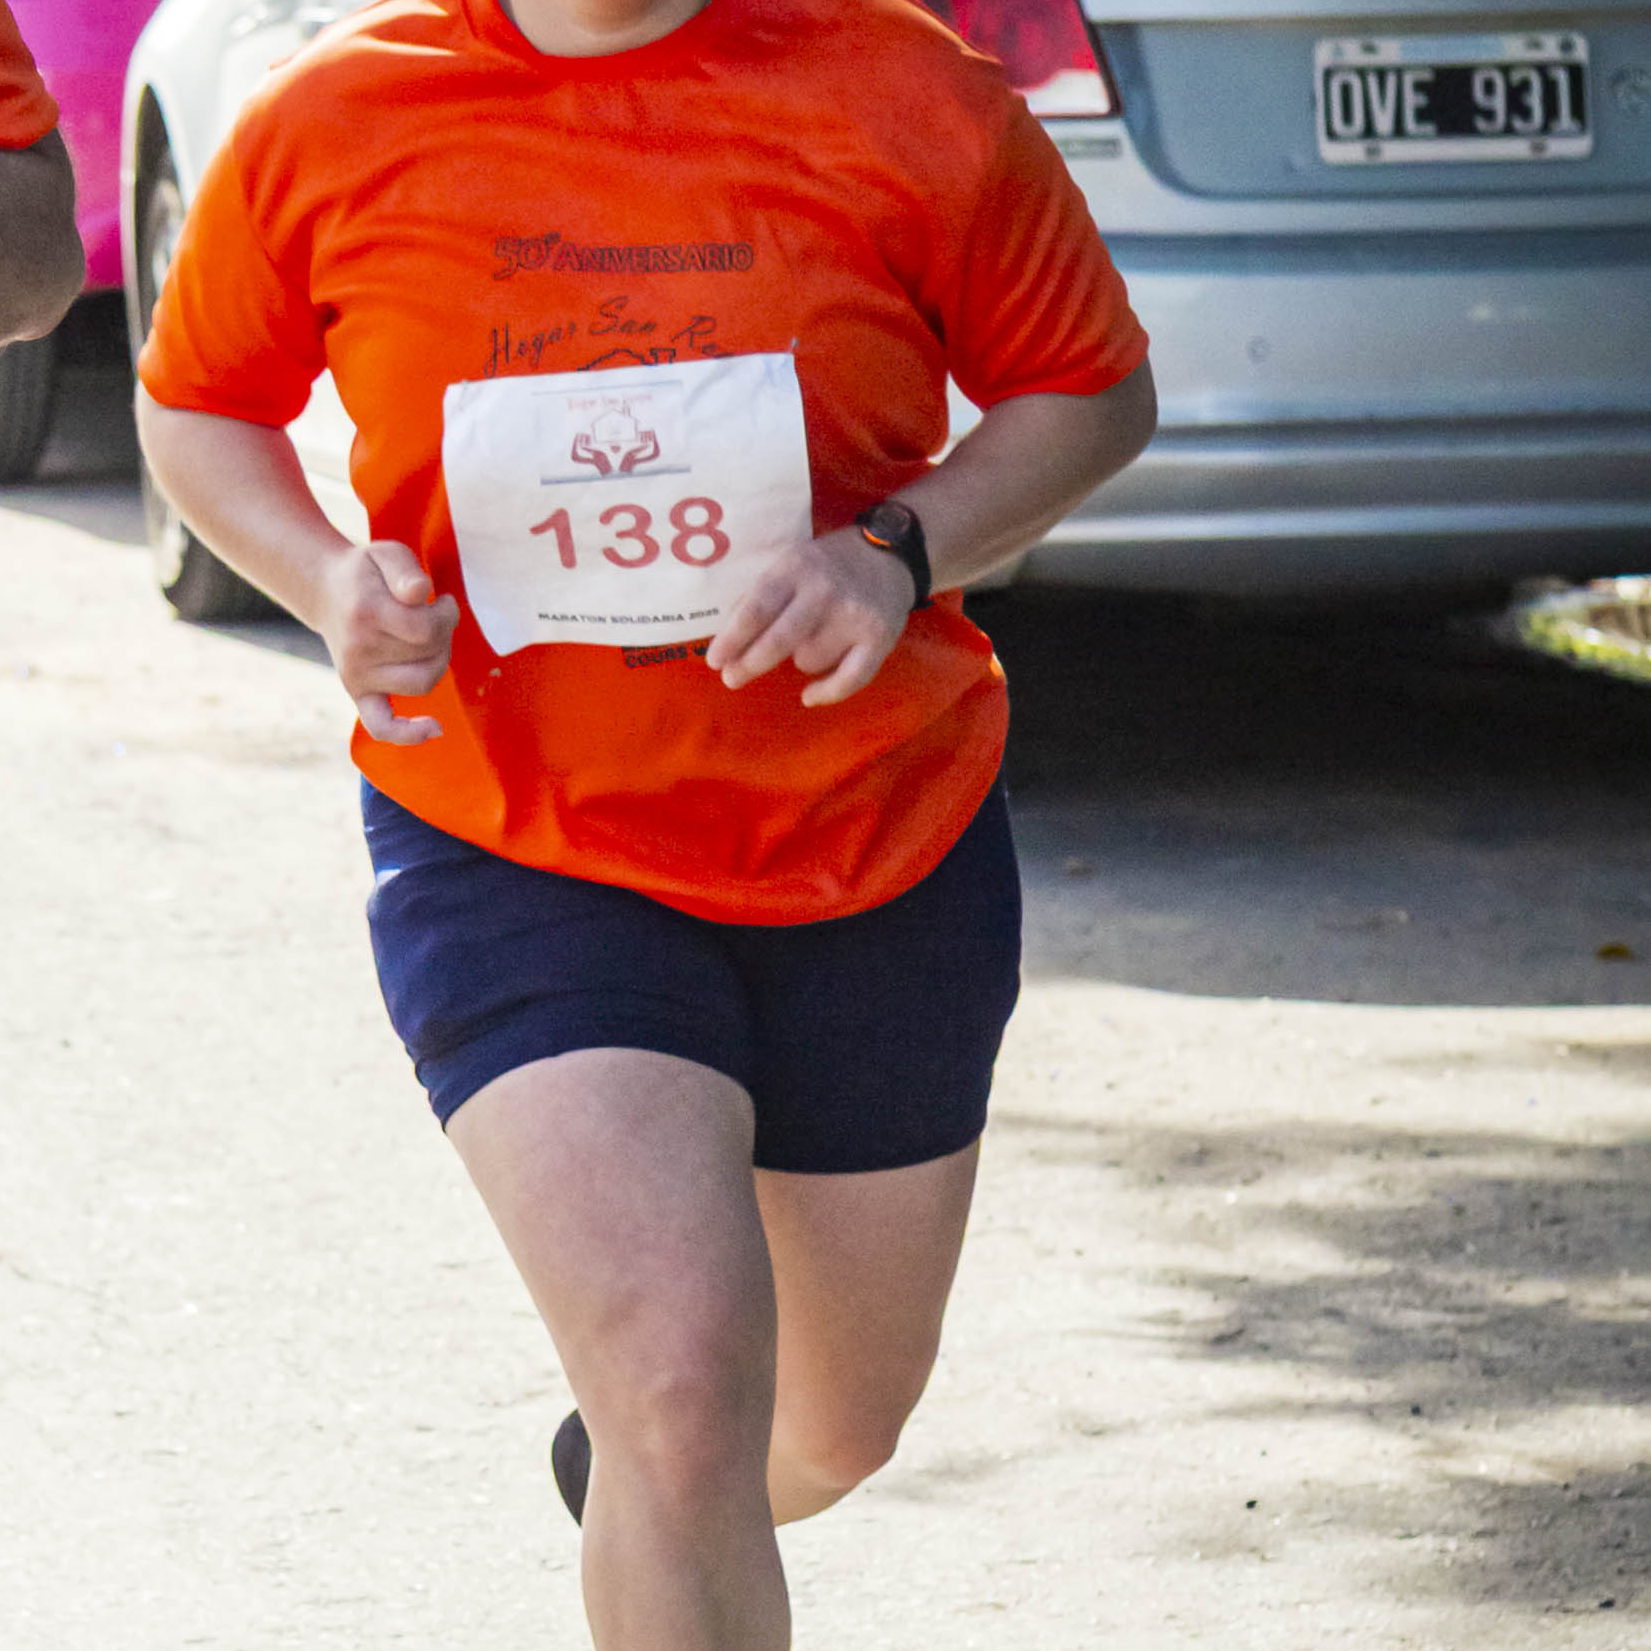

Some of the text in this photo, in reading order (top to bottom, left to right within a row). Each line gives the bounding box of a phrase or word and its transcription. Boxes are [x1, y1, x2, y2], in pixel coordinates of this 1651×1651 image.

[1328, 64, 1581, 138] OVE 931
[552, 242, 754, 273] ANIVERSARIO
[484, 321, 576, 378] Hogar
[590, 296, 658, 345] San
[528, 496, 731, 569] 138
[538, 607, 720, 624] MARATON SOLIDARIA 2025
